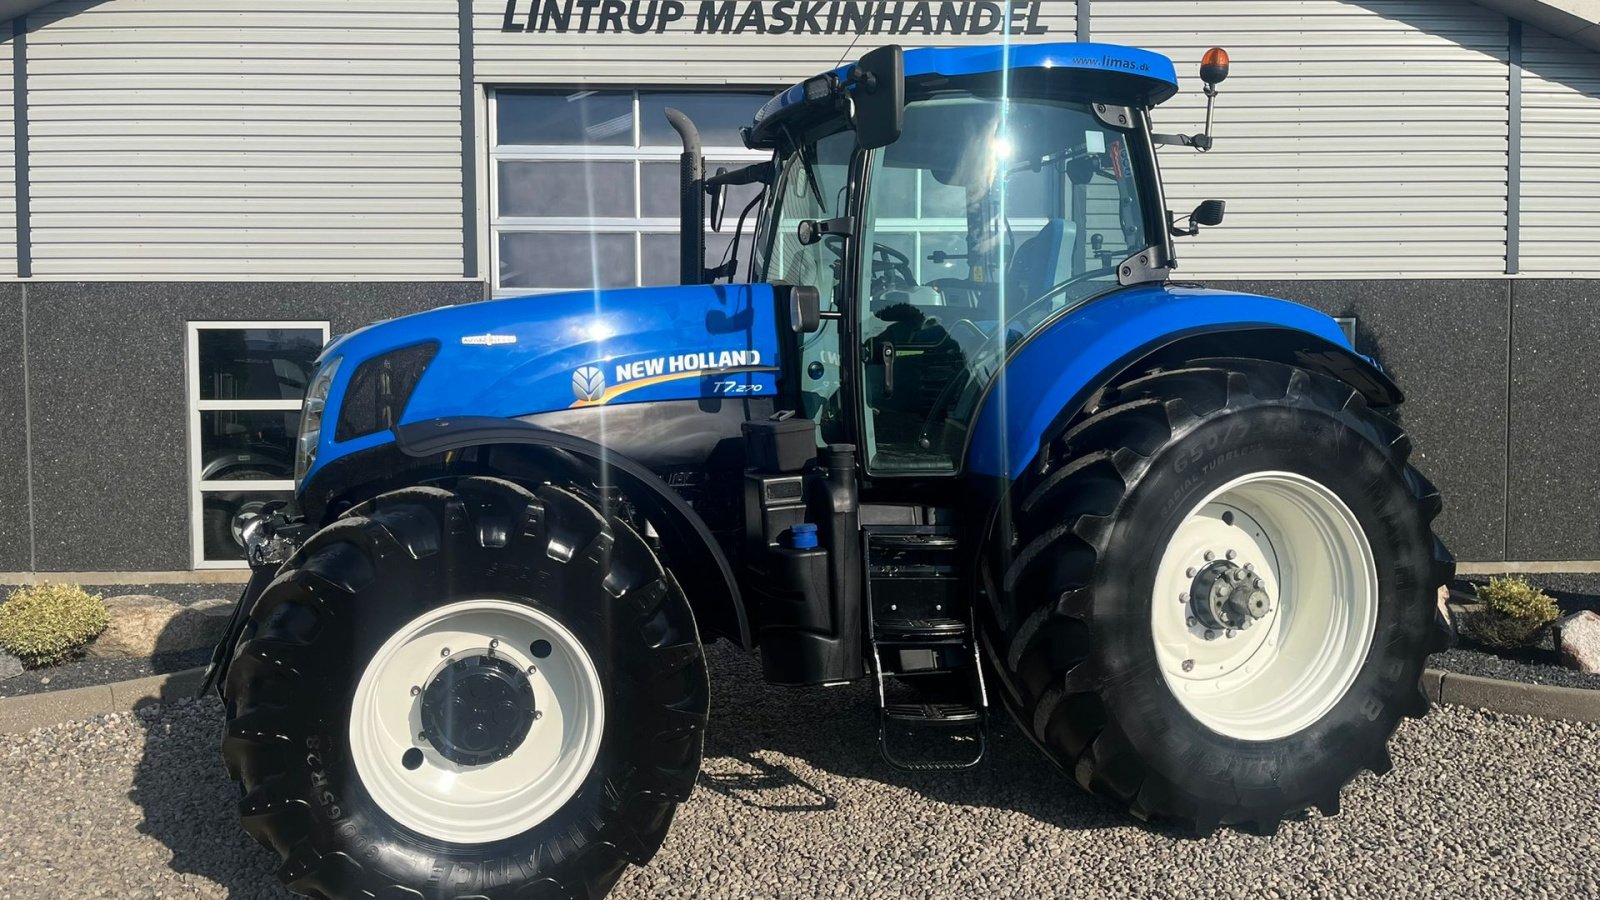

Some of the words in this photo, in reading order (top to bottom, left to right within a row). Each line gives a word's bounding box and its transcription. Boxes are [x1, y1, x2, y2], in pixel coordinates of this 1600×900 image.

[501, 0, 684, 35] LINTRUP
[694, 0, 1048, 36] MASKINHANDEL
[1072, 55, 1151, 72] www.limas.dk
[615, 358, 665, 383] NEW
[669, 350, 761, 373] HOLLAND
[713, 381, 763, 394] T7.270
